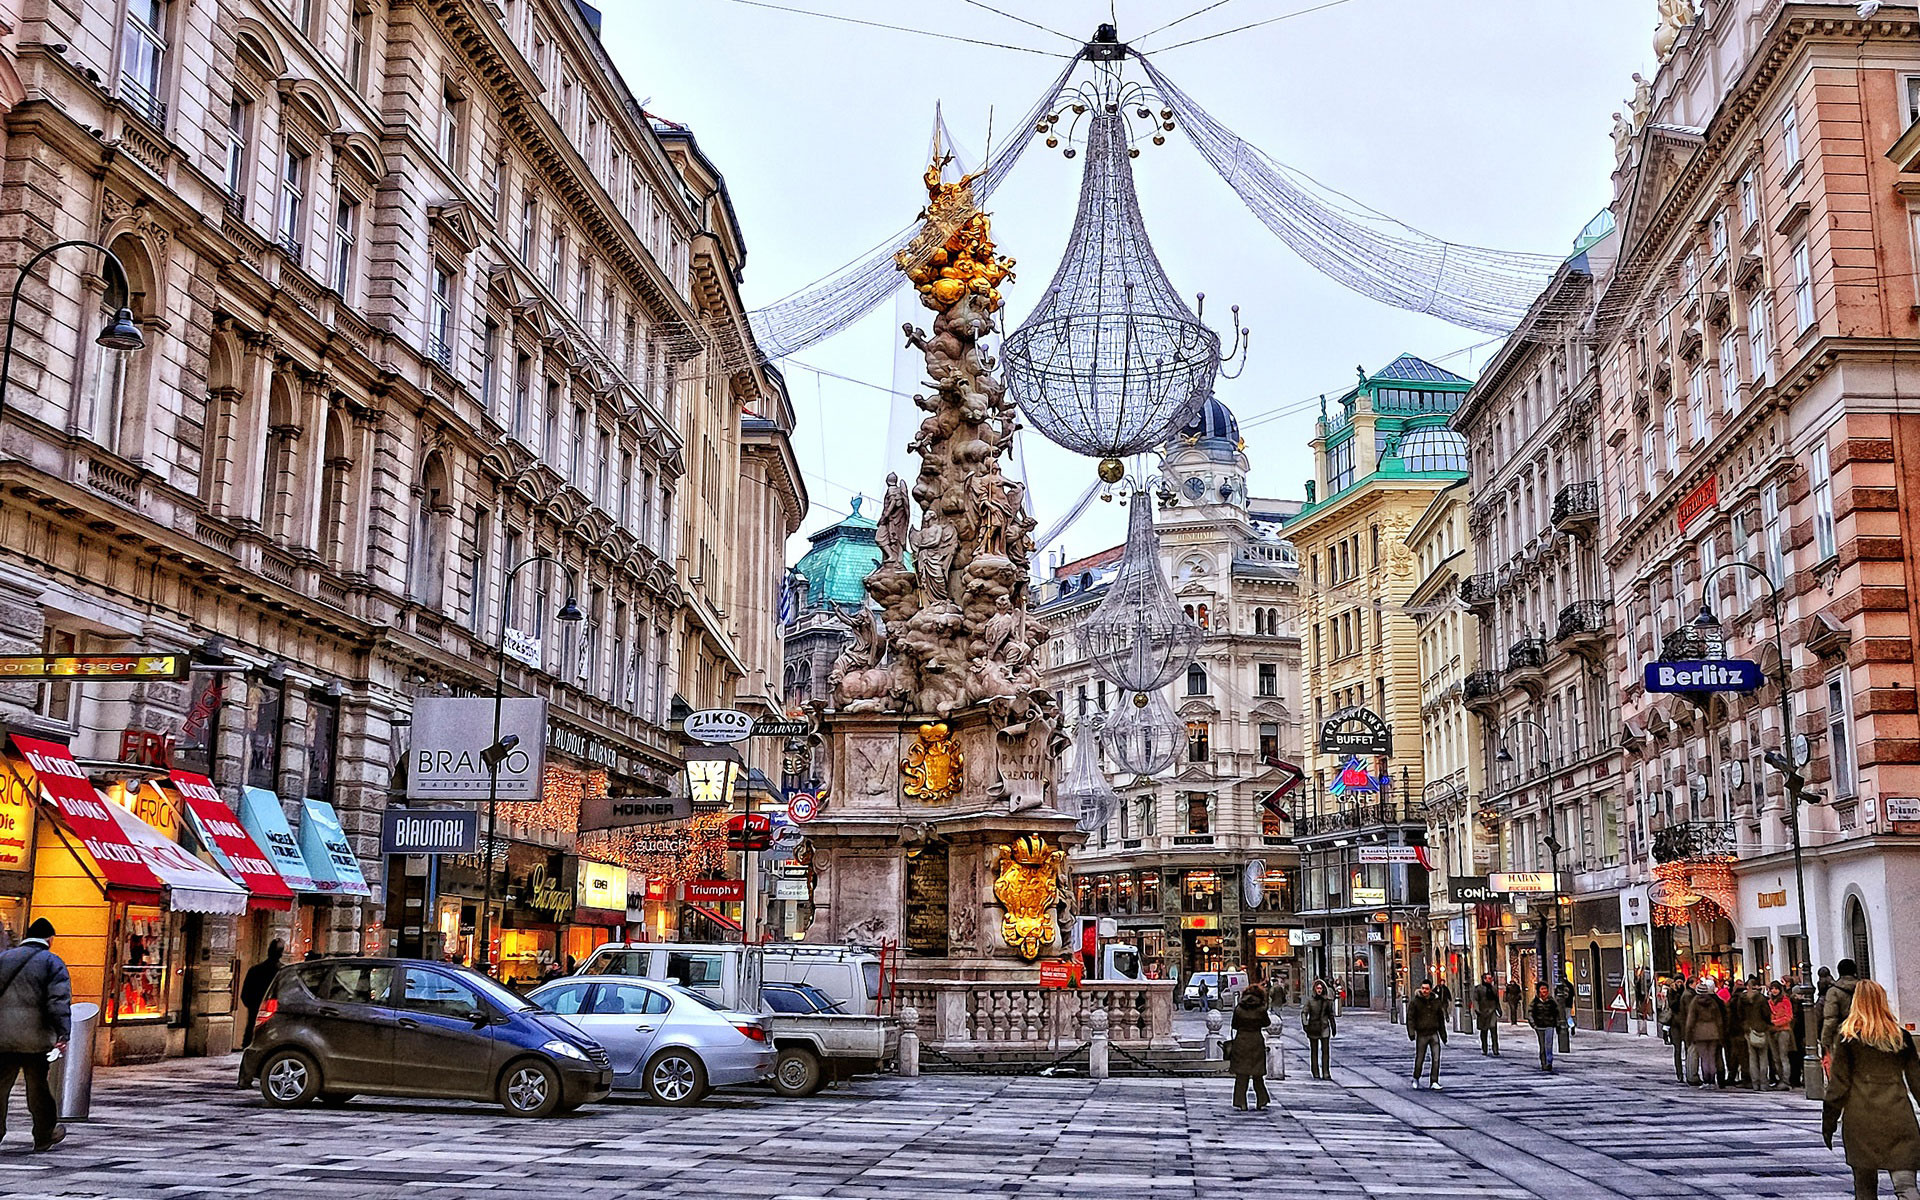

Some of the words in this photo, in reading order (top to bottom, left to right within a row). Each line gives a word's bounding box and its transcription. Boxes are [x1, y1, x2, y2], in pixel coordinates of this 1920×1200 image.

[1658, 664, 1744, 686] Berlitz
[692, 712, 747, 728] ZIKOS
[1336, 735, 1374, 745] BUFFET
[59, 796, 109, 822] BOOKS
[612, 803, 674, 816] HÜBNER
[205, 818, 246, 839] BOOKS
[690, 884, 731, 897] Triumph
